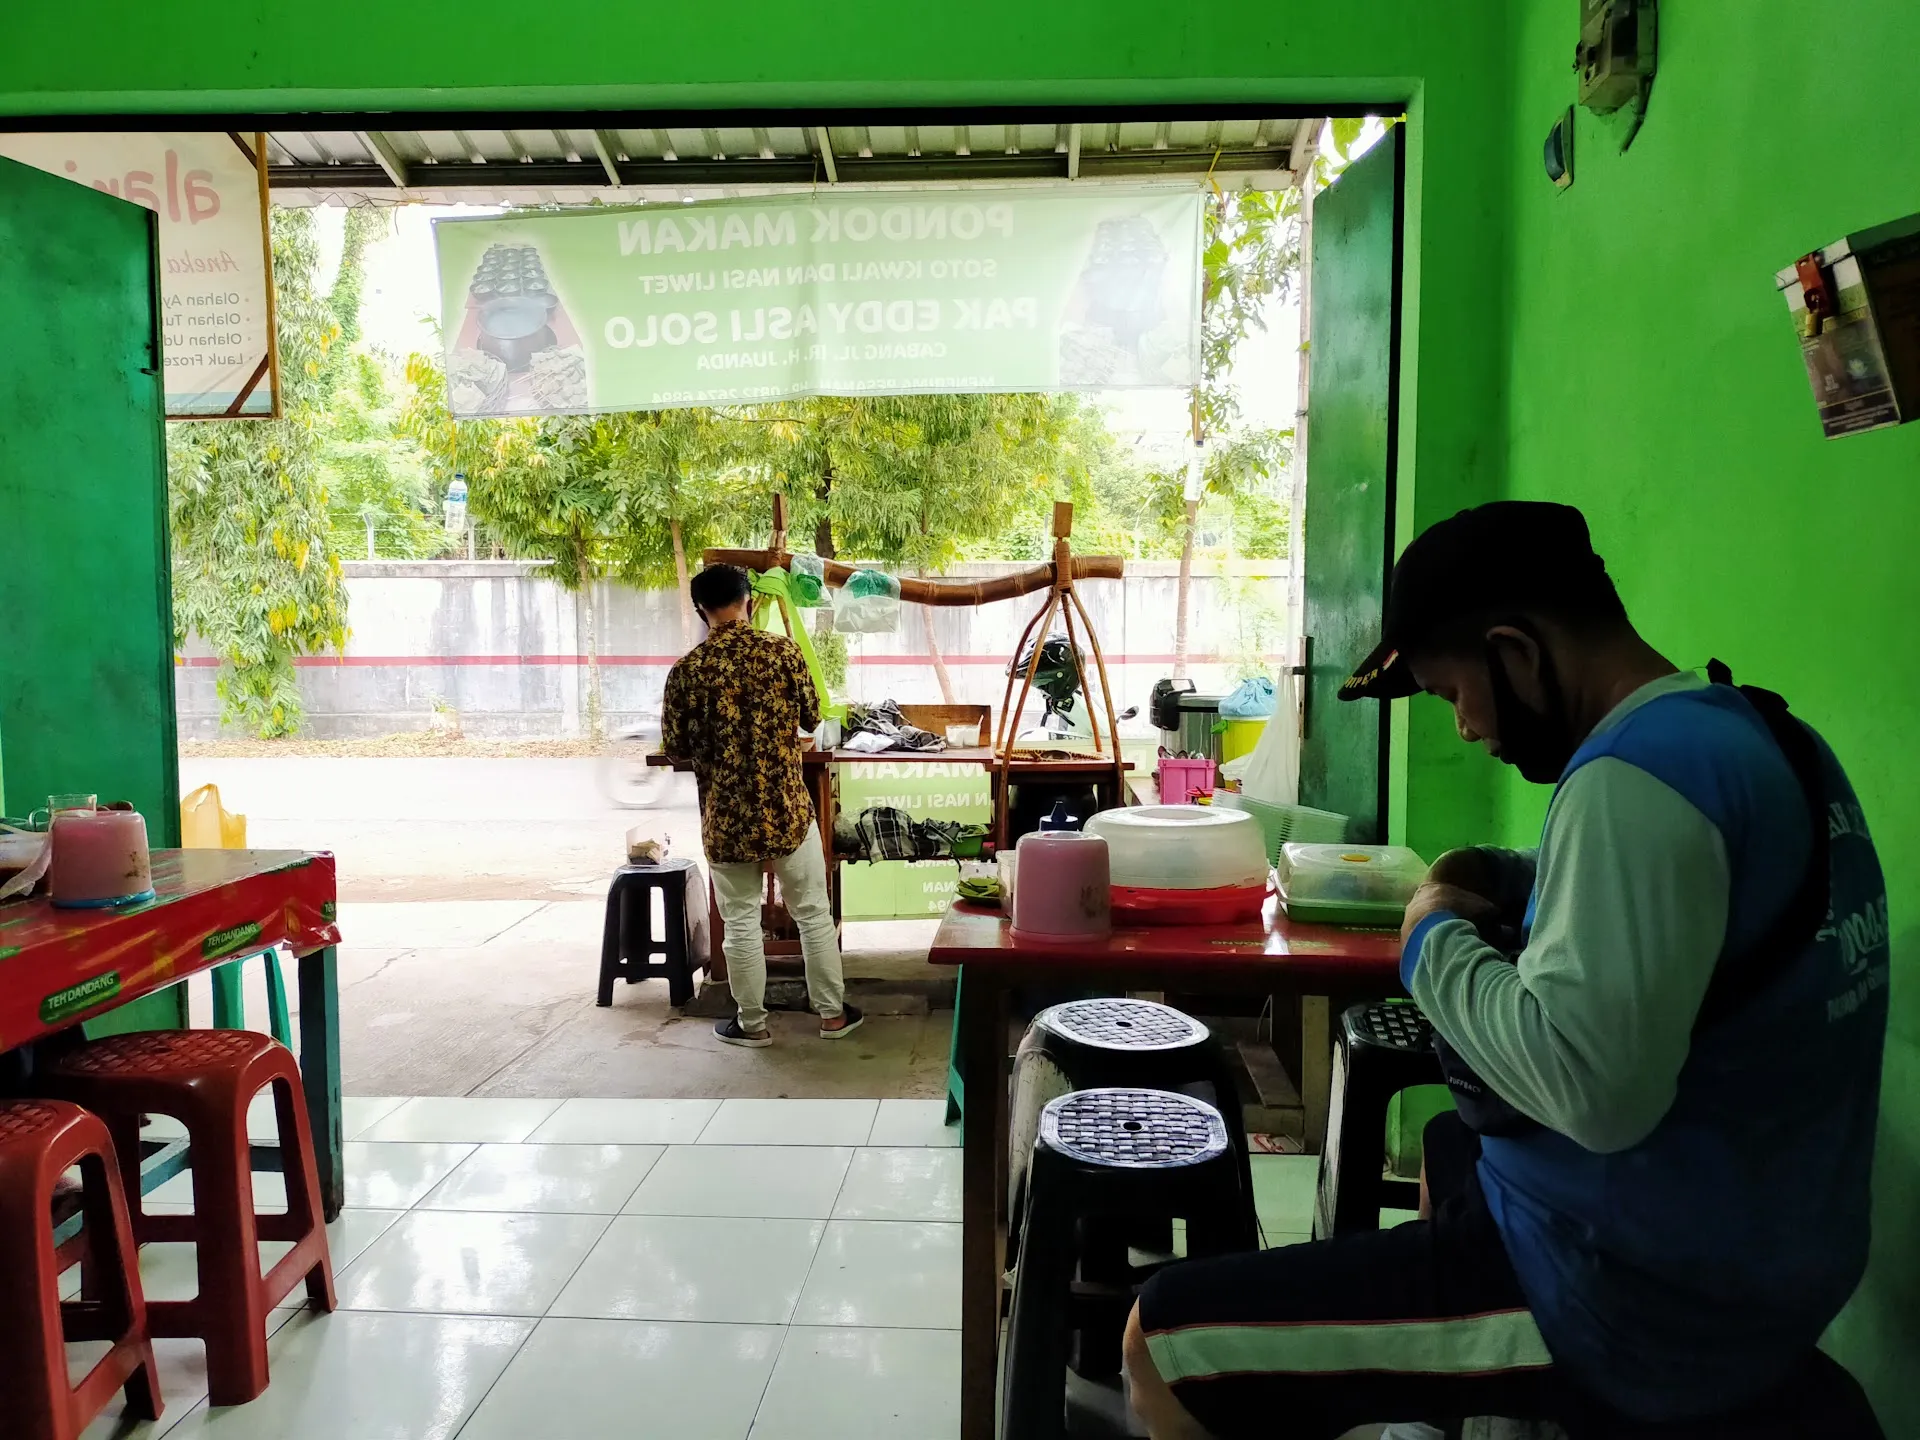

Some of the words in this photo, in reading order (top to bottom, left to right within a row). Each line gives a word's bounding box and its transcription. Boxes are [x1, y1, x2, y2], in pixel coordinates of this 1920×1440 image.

[220, 923, 258, 944] DANDANG
[47, 991, 68, 1009] TEH
[67, 972, 115, 1002] DANDANG
